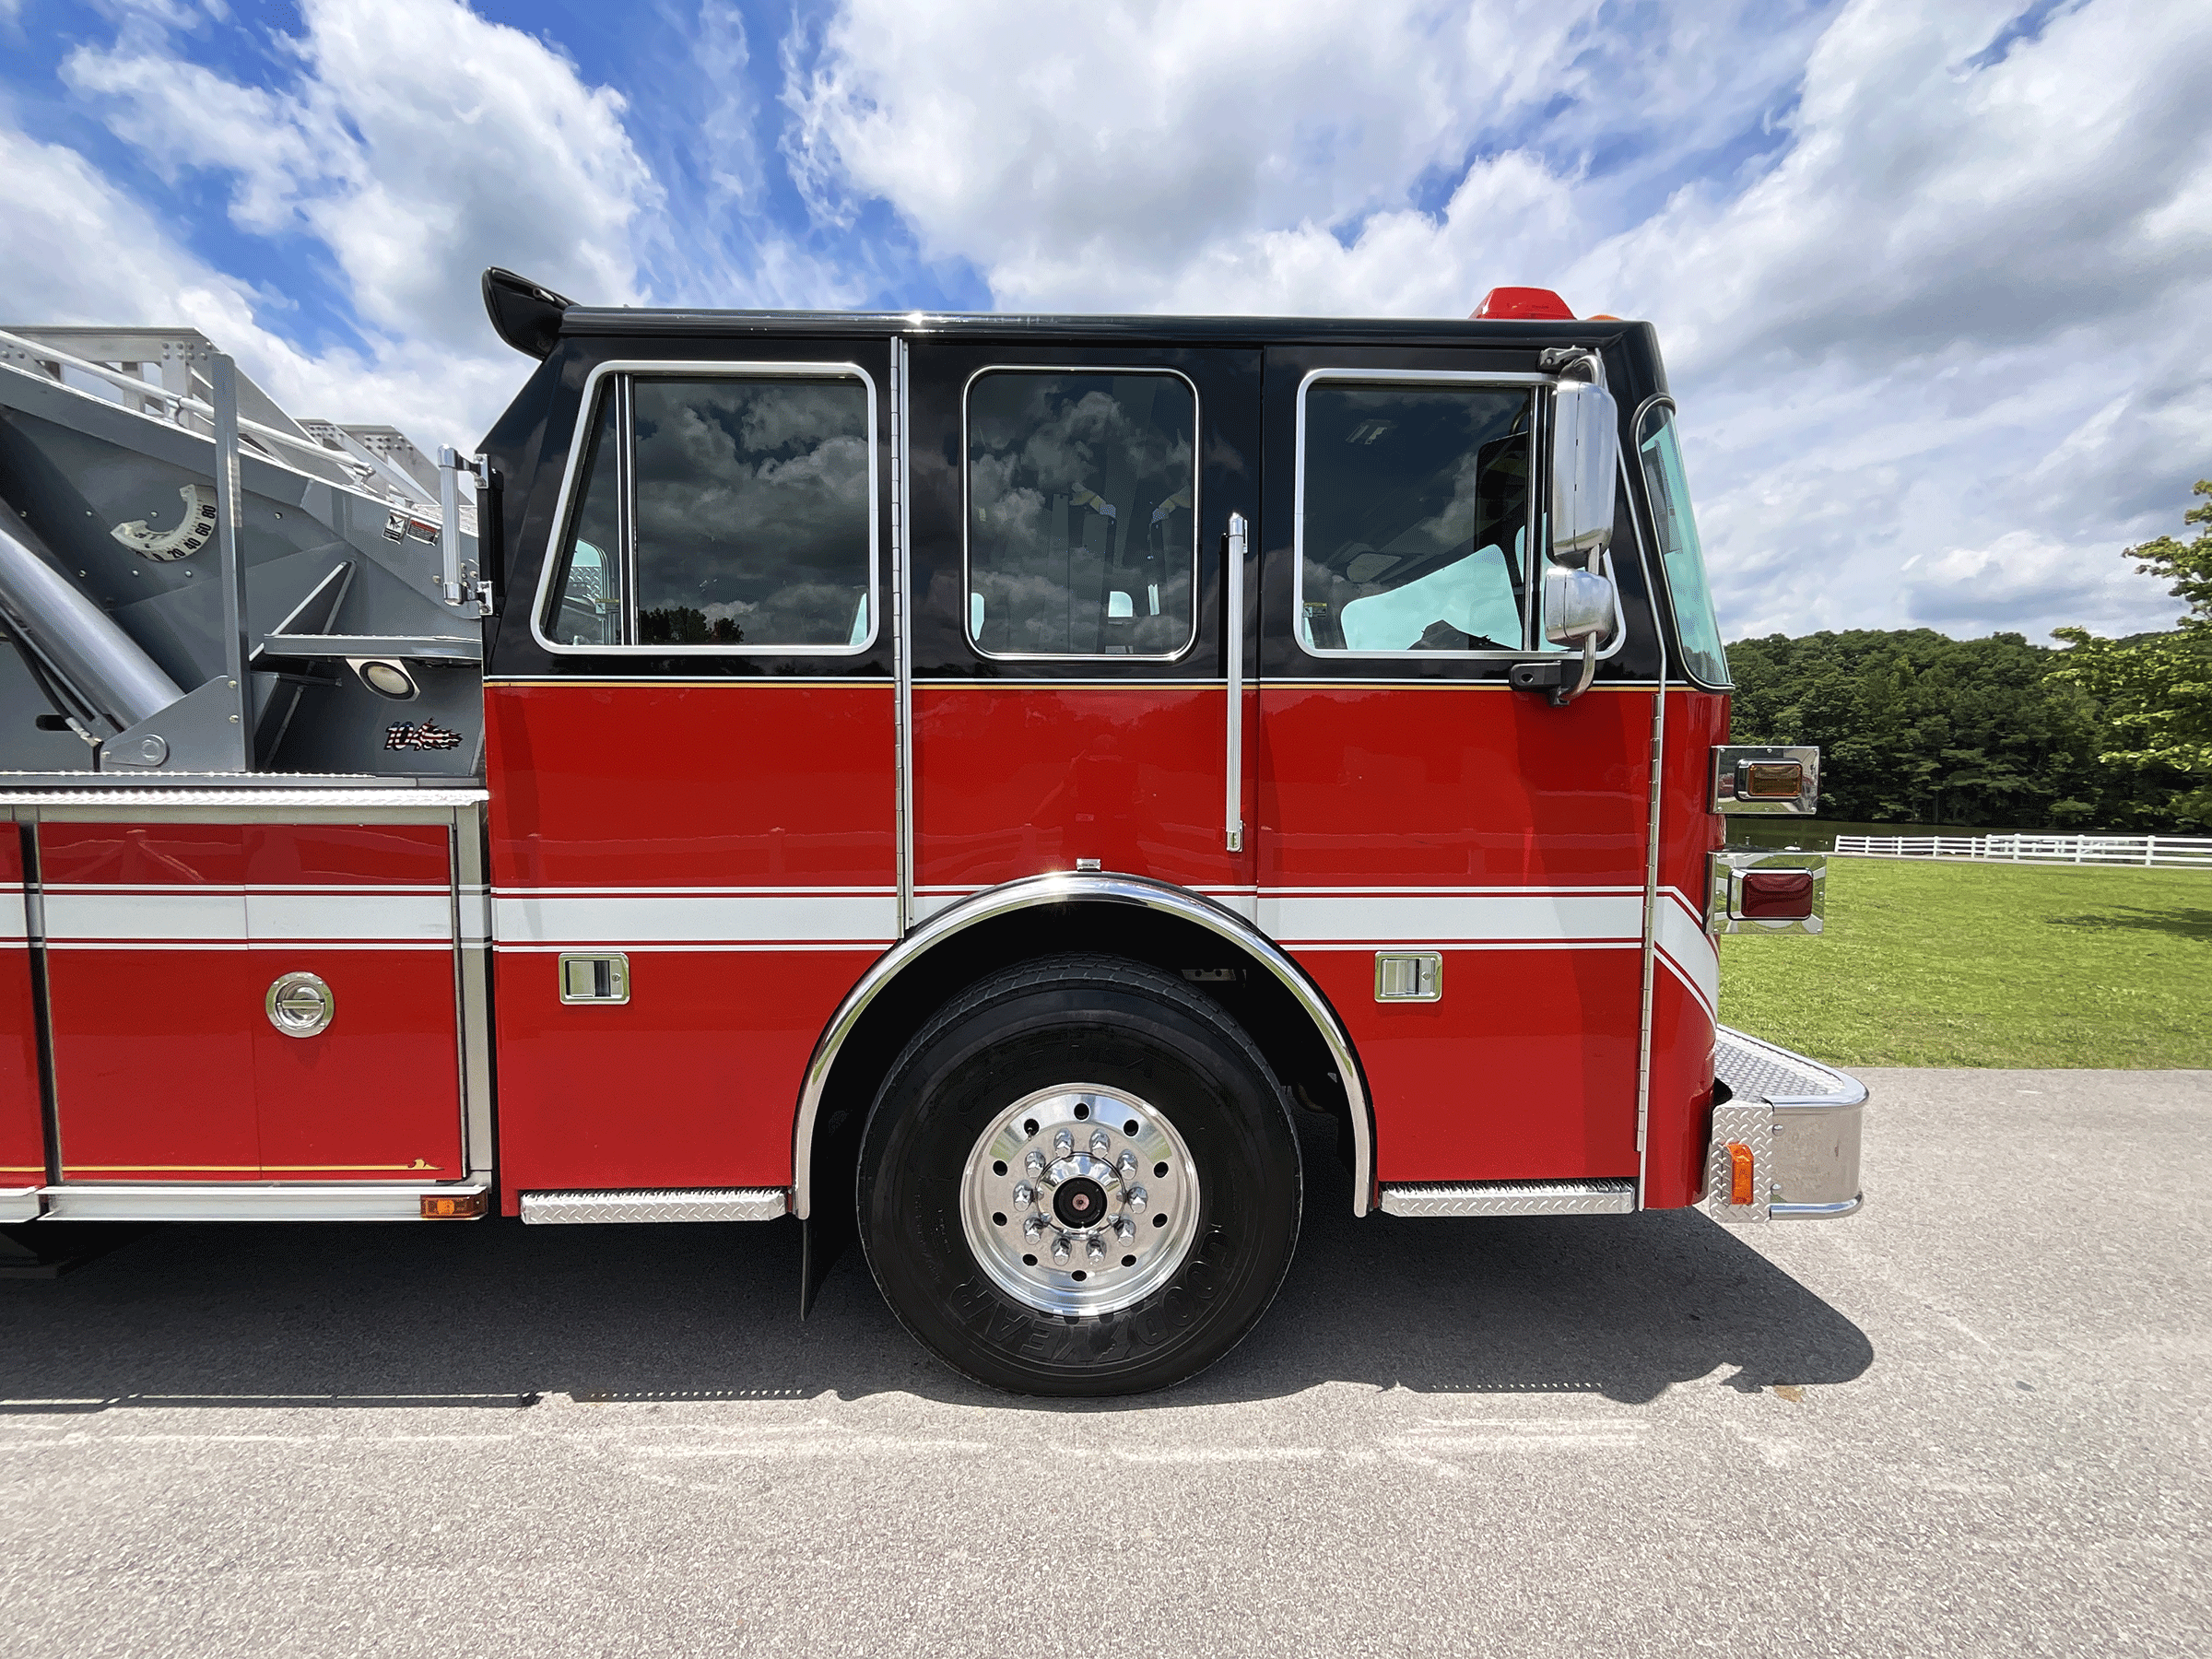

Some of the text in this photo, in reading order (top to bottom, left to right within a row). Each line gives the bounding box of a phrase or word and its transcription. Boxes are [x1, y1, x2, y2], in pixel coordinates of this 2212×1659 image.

[201, 504, 217, 519] 80
[194, 522, 212, 536] 60
[183, 537, 202, 550] 40
[167, 547, 186, 559] 20
[950, 1230, 1237, 1364] GOODYEAR
